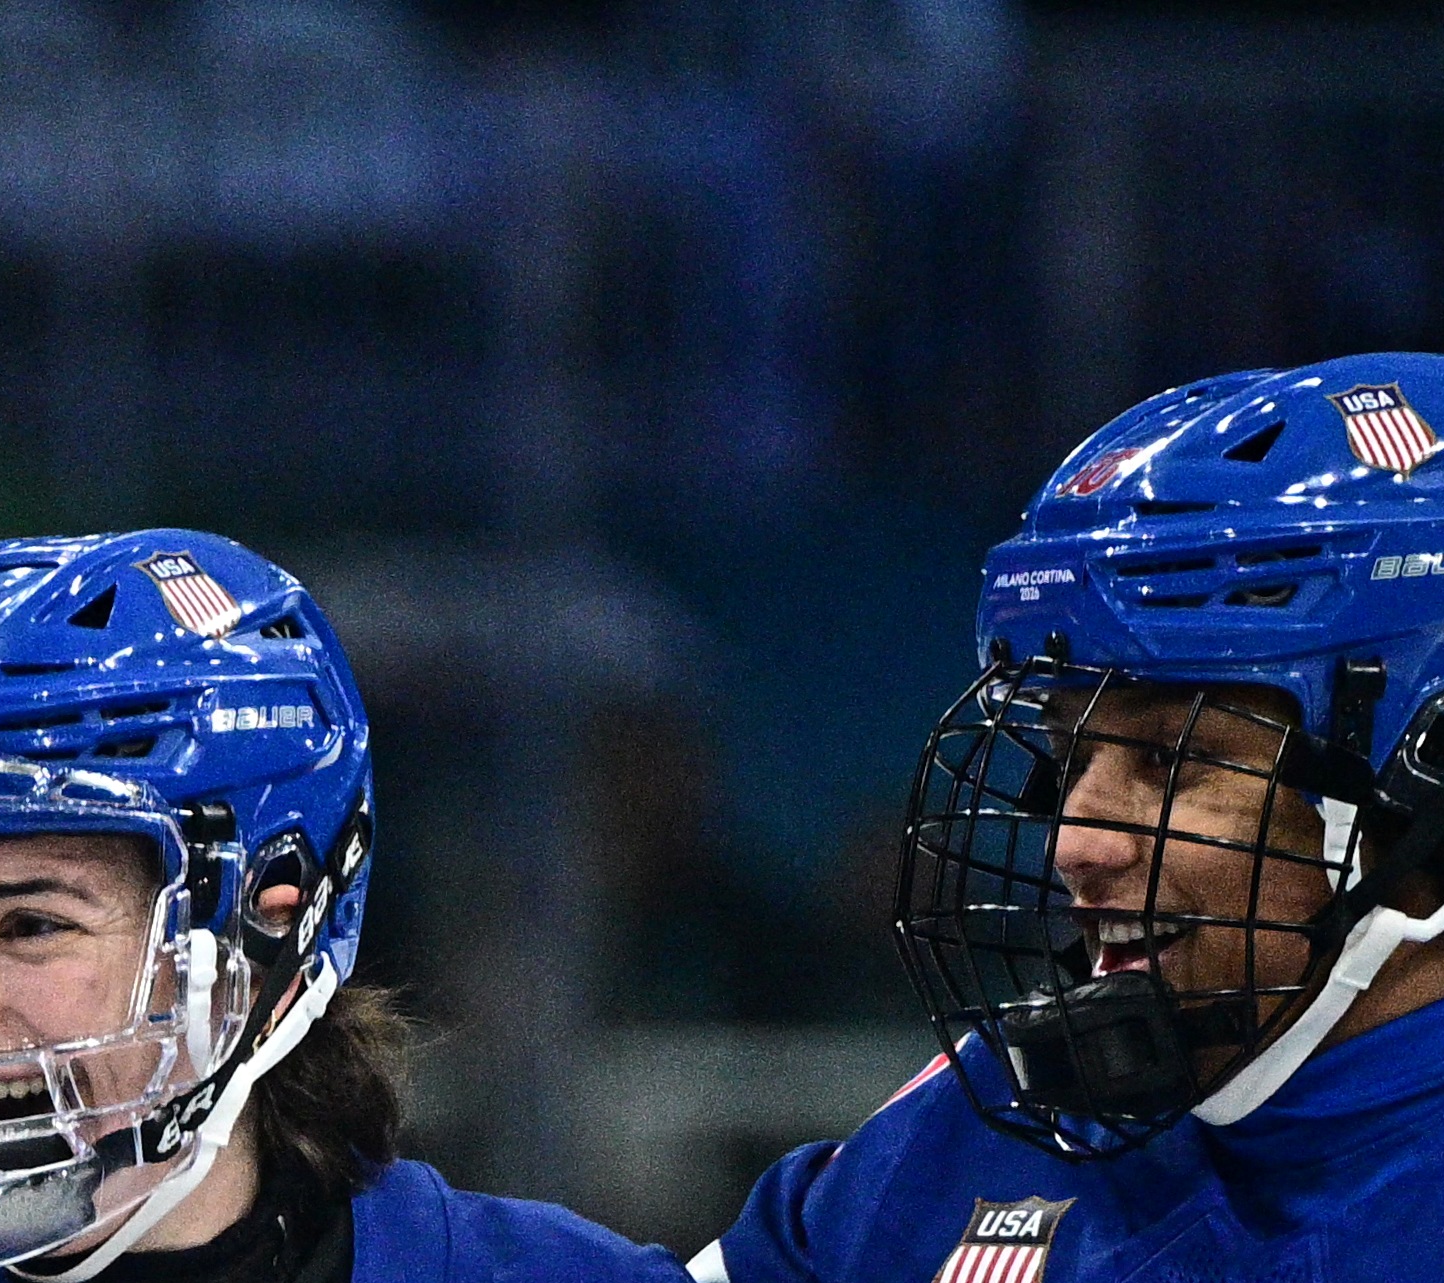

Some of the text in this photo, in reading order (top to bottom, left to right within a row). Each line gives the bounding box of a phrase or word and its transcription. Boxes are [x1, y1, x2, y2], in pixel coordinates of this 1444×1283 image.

[1343, 390, 1395, 413] USA
[150, 556, 196, 579] USA
[993, 568, 1076, 589] MILANO CORTINA
[211, 706, 315, 733] BAUER
[977, 1210, 1044, 1238] USA
